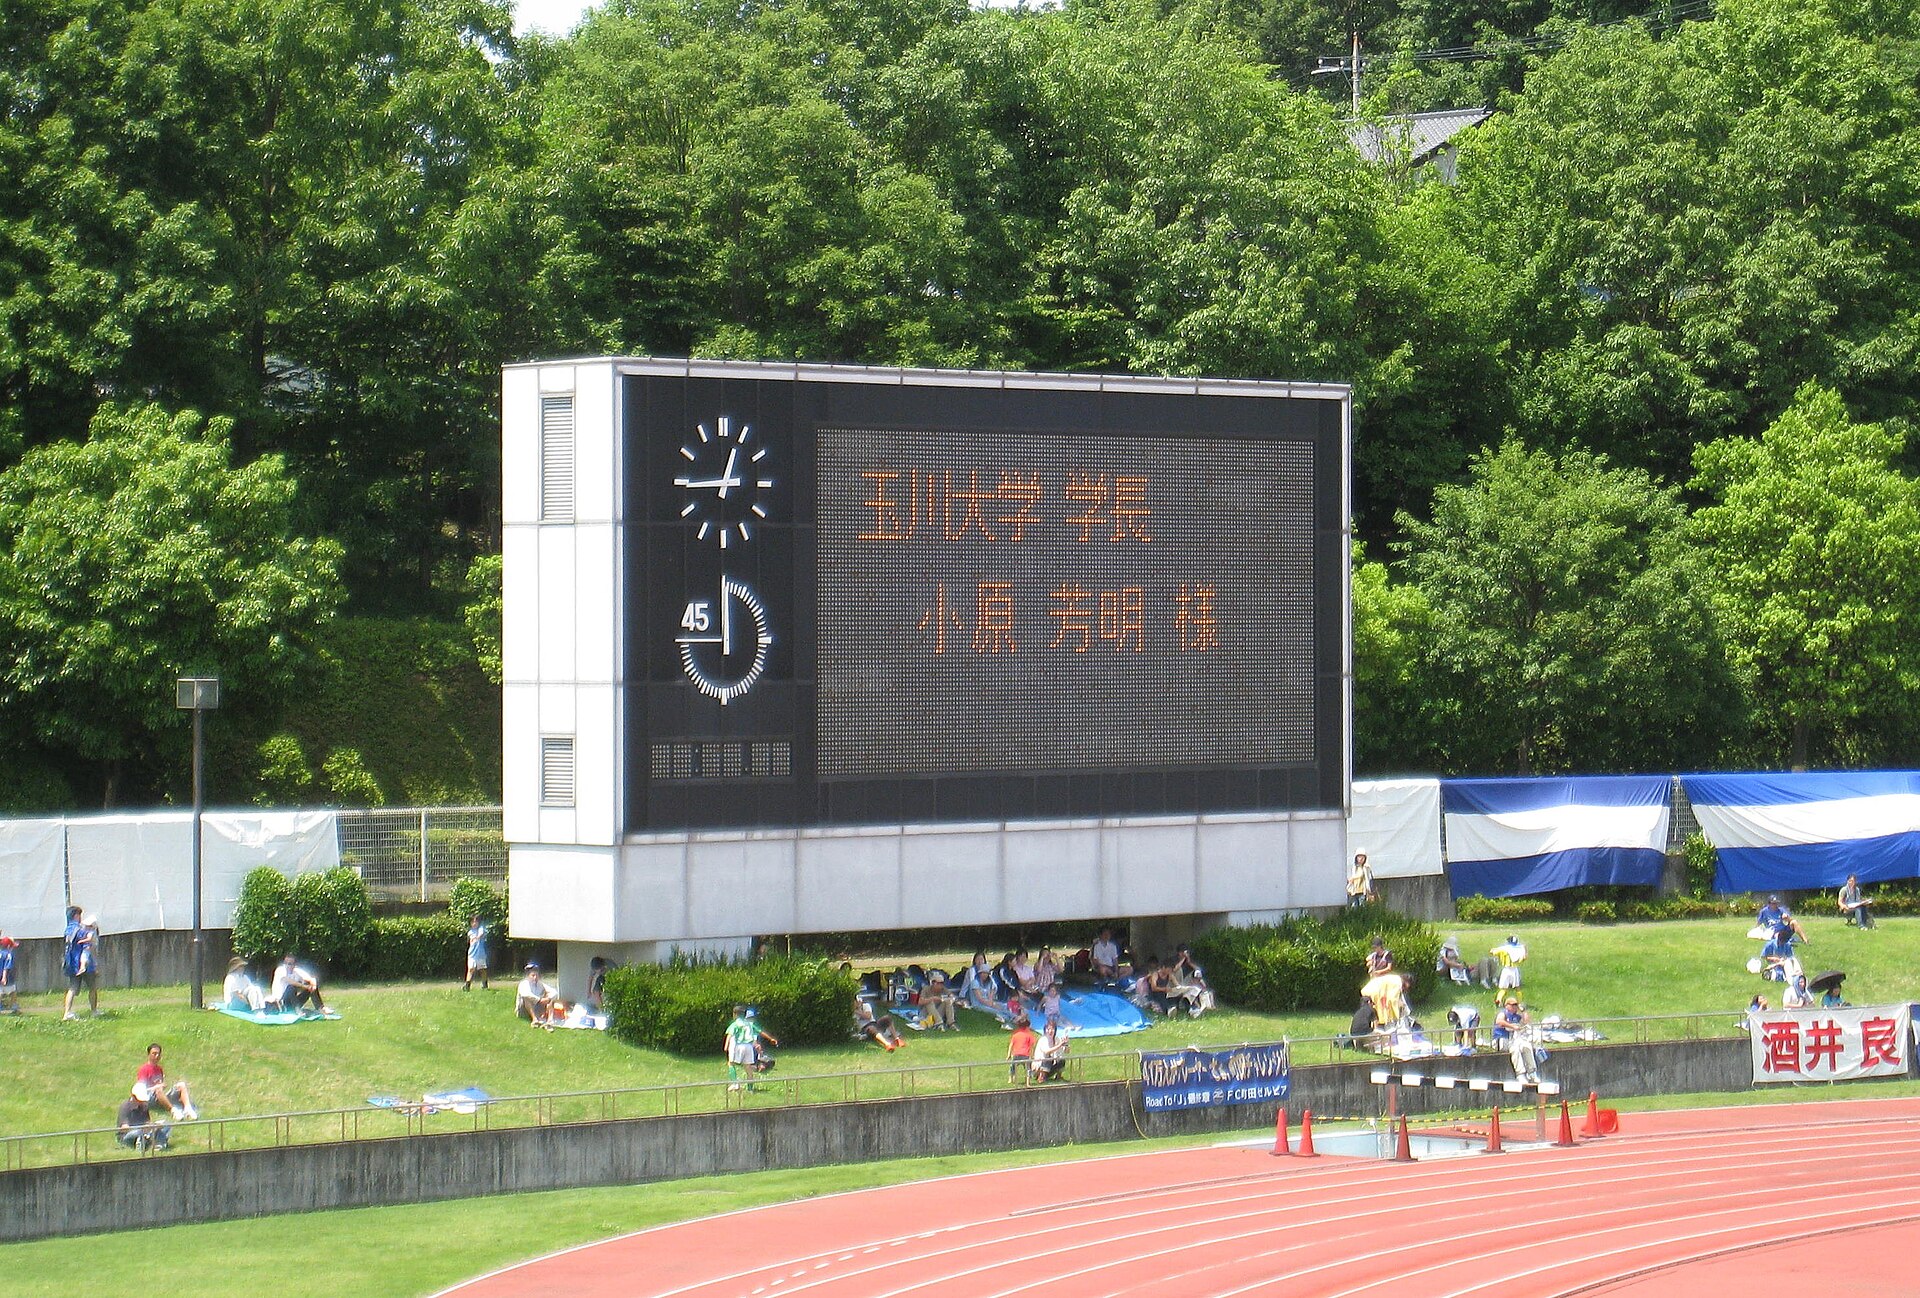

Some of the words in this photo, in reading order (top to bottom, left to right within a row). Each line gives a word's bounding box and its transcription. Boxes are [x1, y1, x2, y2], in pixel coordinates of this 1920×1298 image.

[856, 468, 1043, 542] 玉川大学
[1064, 470, 1152, 543] 学長
[681, 602, 710, 633] 45
[917, 580, 1017, 655] 小原
[1048, 581, 1146, 654] 芳明
[1173, 582, 1220, 654] 様
